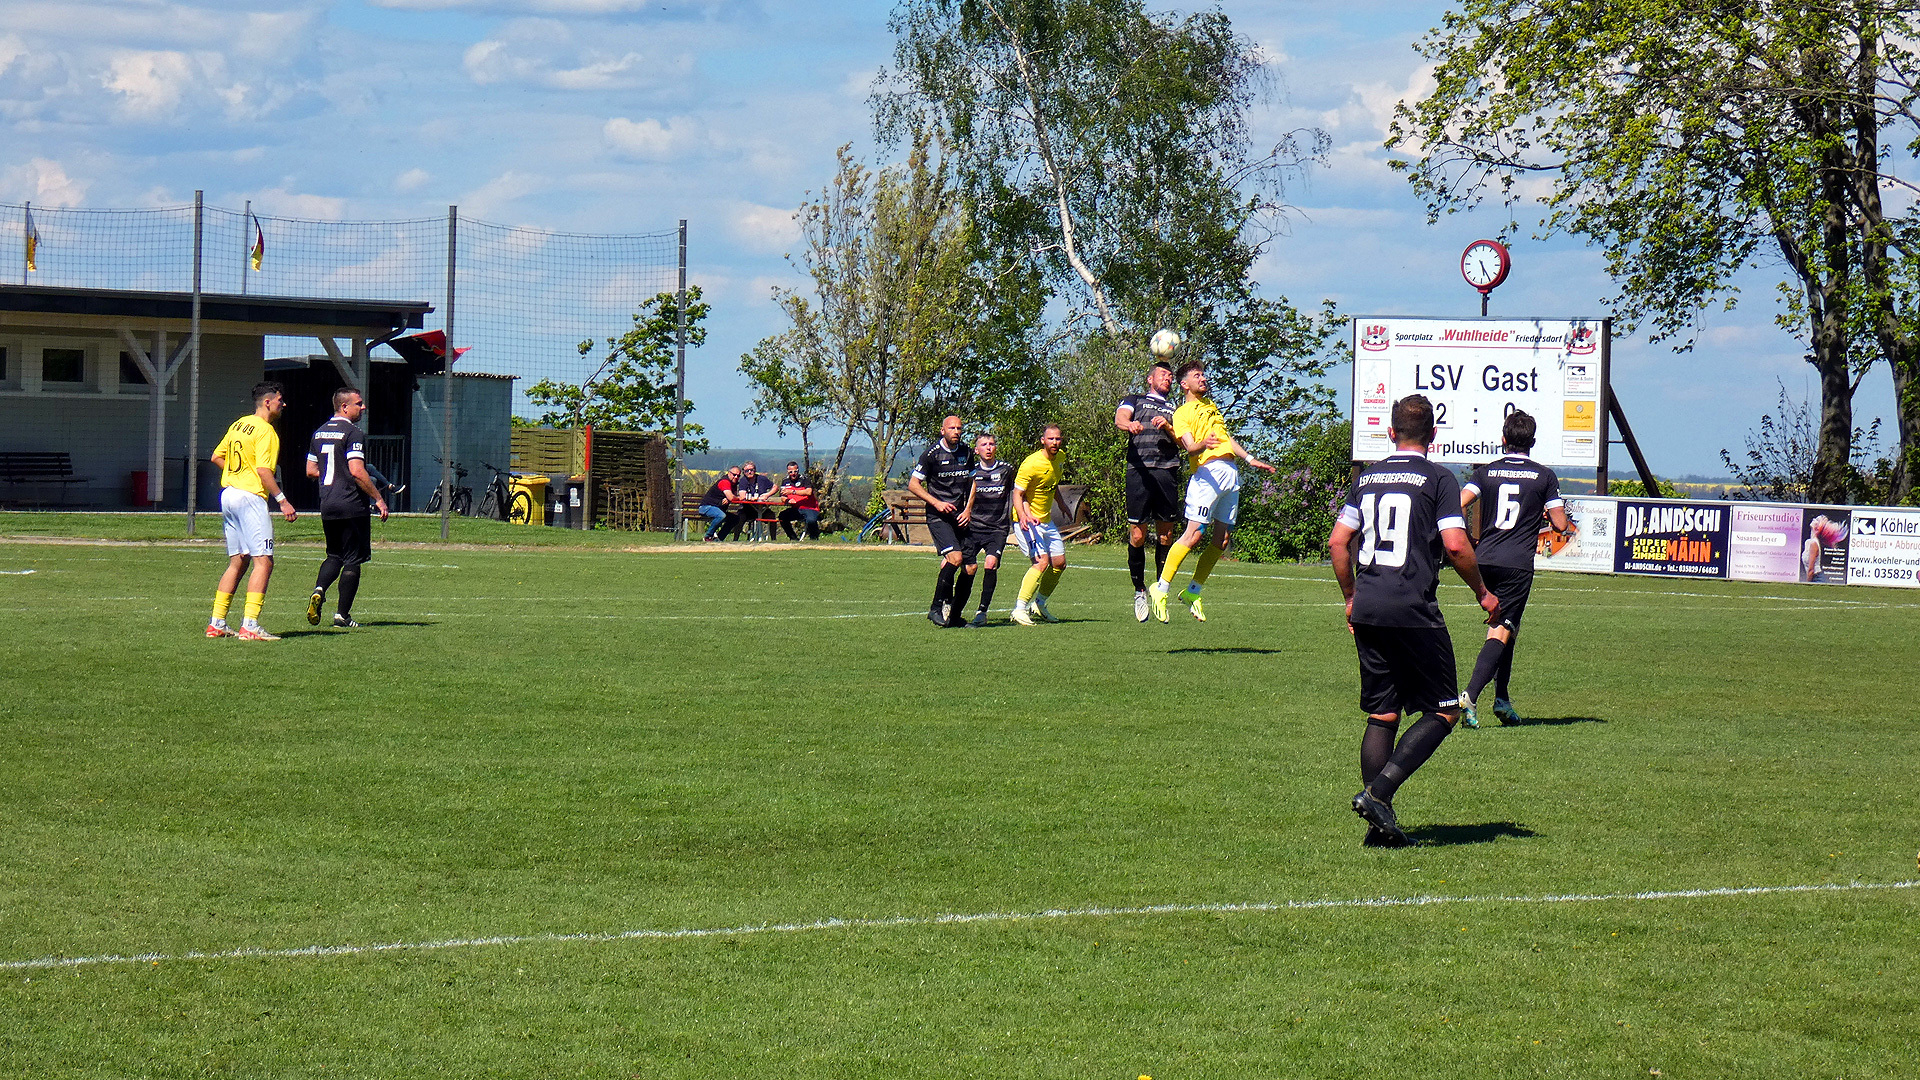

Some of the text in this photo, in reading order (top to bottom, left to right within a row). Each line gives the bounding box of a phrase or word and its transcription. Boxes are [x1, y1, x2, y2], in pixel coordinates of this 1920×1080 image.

[1366, 325, 1386, 336] LSV
[1395, 332, 1433, 341] Sportplatz
[1515, 334, 1563, 343] Friedersdorf
[1415, 364, 1539, 392] LSV Gast
[1435, 402, 1447, 425] 2
[242, 423, 255, 436] 09
[320, 444, 335, 486] 7
[1358, 472, 1428, 488] LSV FRIEDERSDORF
[1487, 469, 1540, 480] LSV FRIEDERSDORF
[1197, 505, 1209, 518] 10
[1494, 483, 1520, 530] 6
[1624, 506, 1721, 538] DJ ANDSCHI
[1880, 517, 1919, 534] Köhler
[1358, 493, 1412, 567] 19
[264, 538, 274, 550] 16
[1632, 538, 1668, 546] SUPER
[1736, 534, 1760, 542] Susanne
[1850, 538, 1920, 550] Schüttgut Abbruc
[1631, 552, 1667, 561] ZIMMER
[1850, 555, 1920, 566] www.koehler-und
[1624, 562, 1662, 571] DJ-ANDSCHI.de
[1850, 566, 1913, 580] Tel.: 035829
